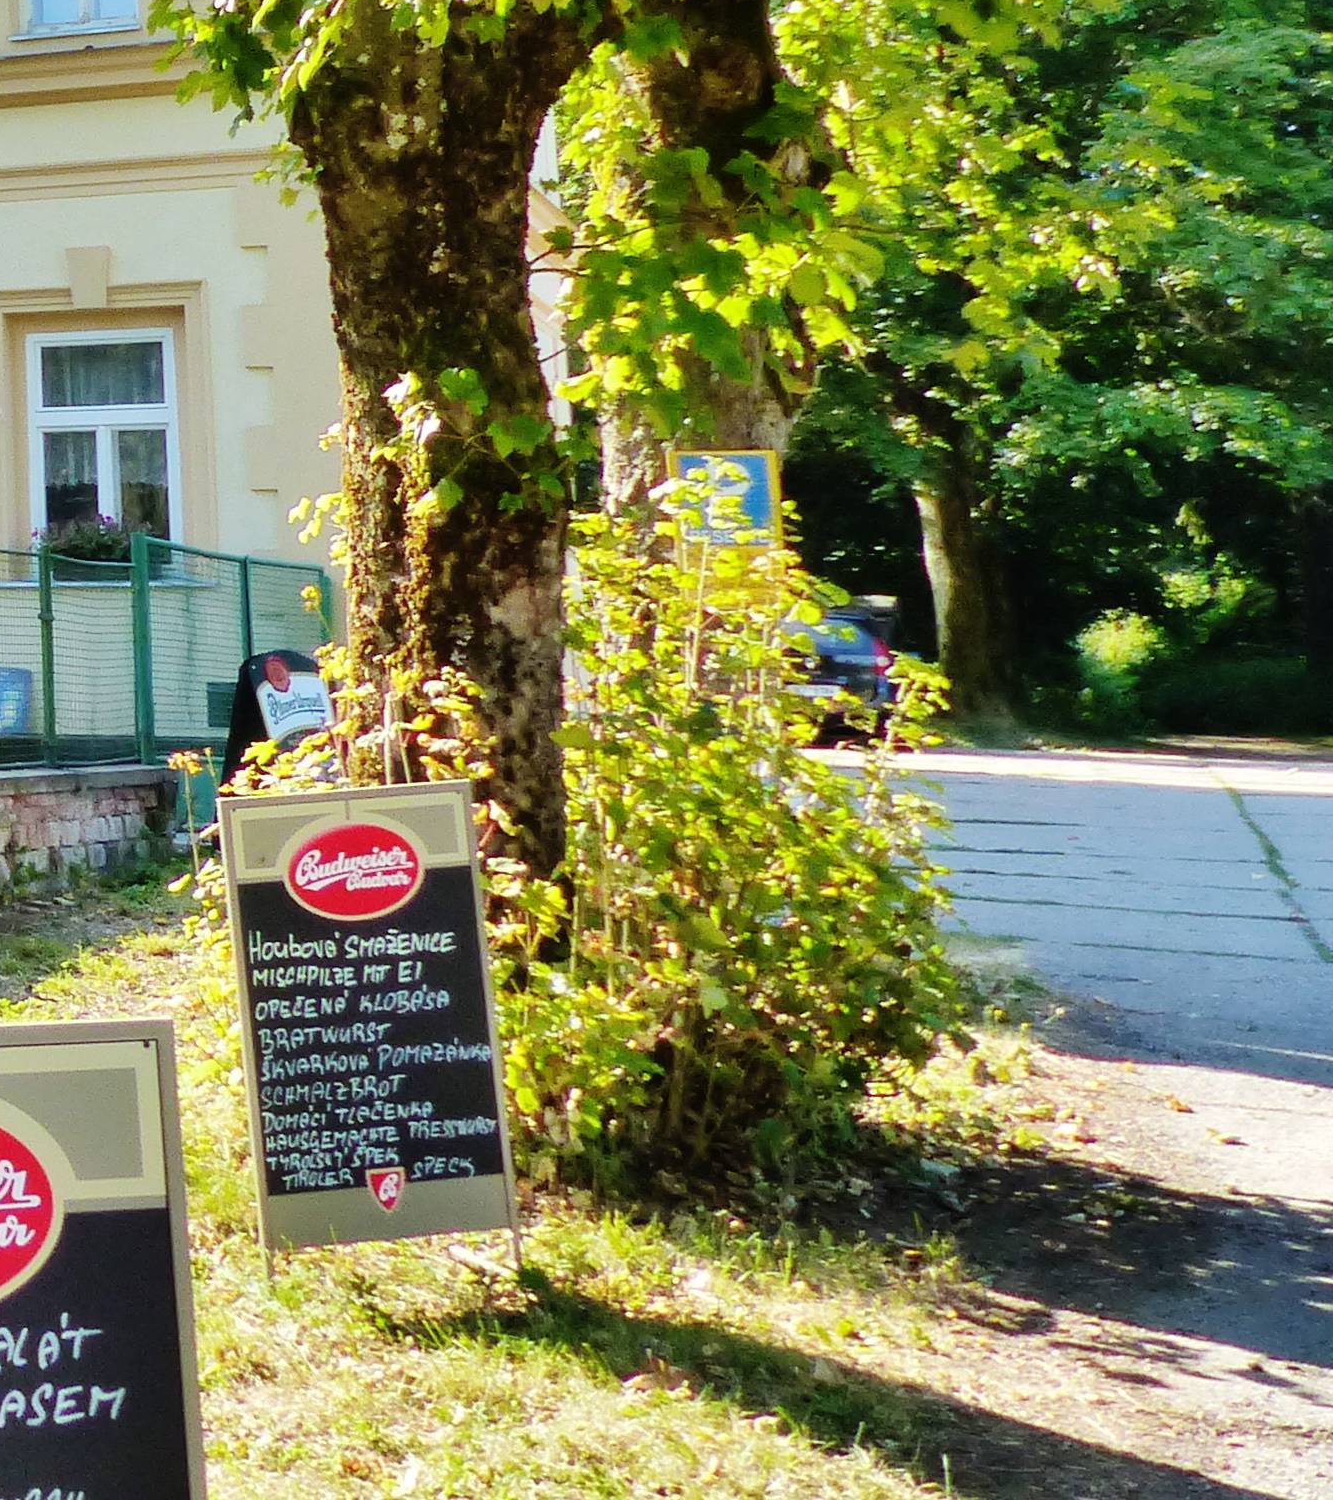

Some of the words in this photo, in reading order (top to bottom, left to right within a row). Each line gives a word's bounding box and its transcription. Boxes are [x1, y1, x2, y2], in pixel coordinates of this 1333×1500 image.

[295, 846, 414, 886] Budweiser
[252, 965, 358, 988] MISCHPILZE
[362, 964, 391, 984] MIT
[397, 960, 423, 984] EI
[359, 984, 451, 1015] KLOBÁSA
[258, 1021, 392, 1054] BRATWURST
[260, 1073, 407, 1110] SCHMALZBROT
[265, 1125, 400, 1152] HAUSGEMACHTE
[282, 1168, 355, 1191] TIROLER
[410, 1155, 475, 1180] SPECK
